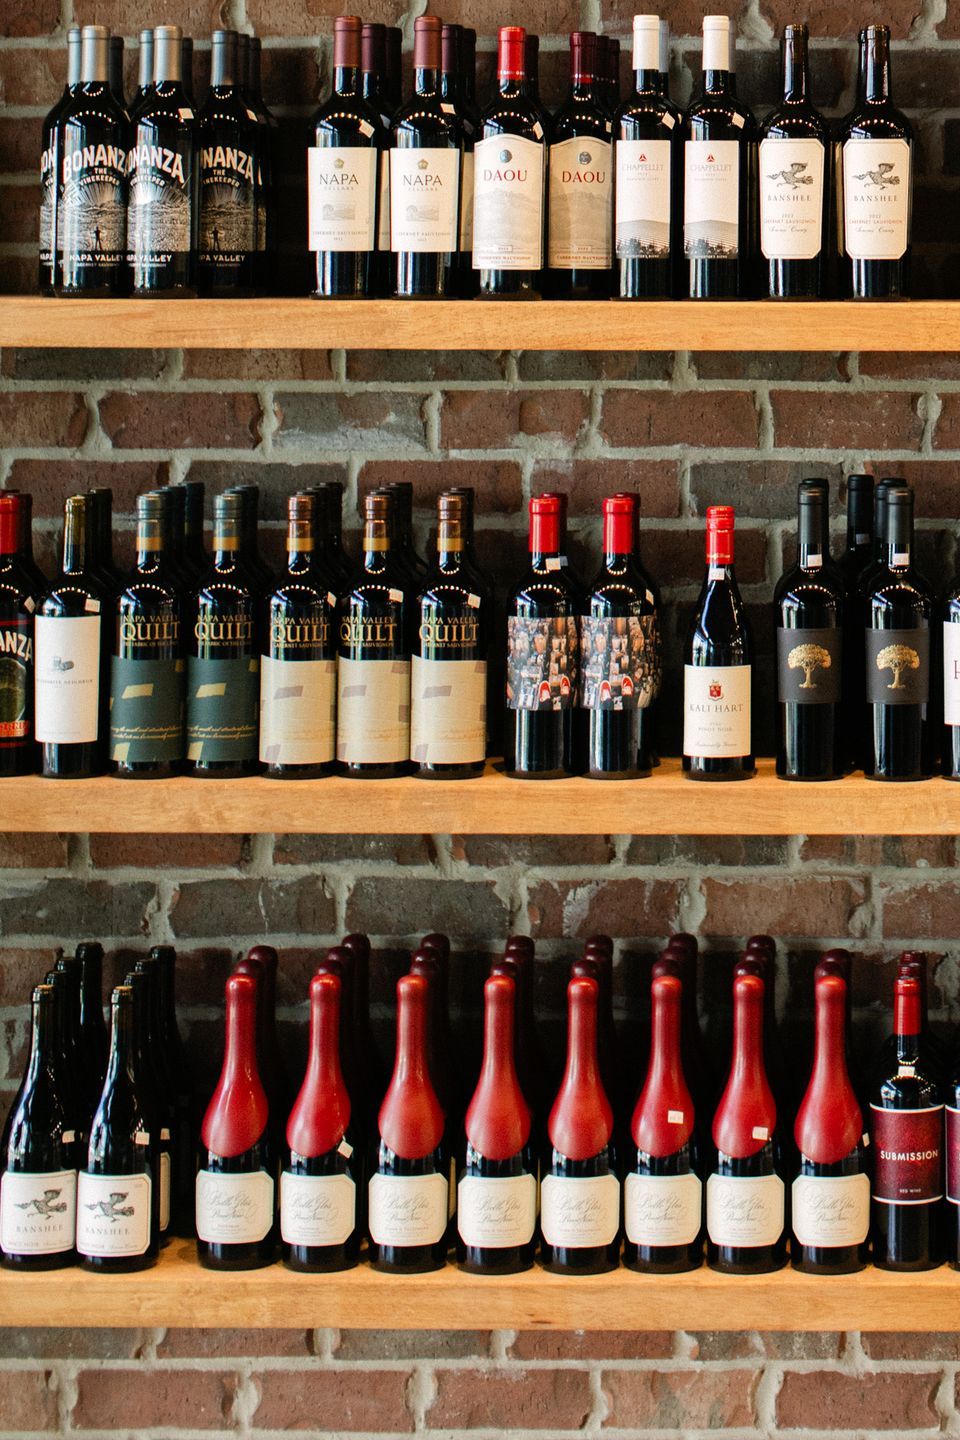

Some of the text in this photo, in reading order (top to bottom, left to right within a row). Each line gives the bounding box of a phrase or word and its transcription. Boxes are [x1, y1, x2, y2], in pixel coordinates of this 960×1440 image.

[319, 174, 359, 185] NAPA
[402, 175, 443, 186] NAPA
[483, 169, 528, 182] DAOU
[562, 170, 606, 183] DAOU
[767, 194, 812, 202] BANSHEE
[853, 194, 898, 202] BANSHEE
[120, 621, 181, 641] QUILT
[194, 621, 254, 641] QUILT
[270, 623, 330, 644] QUILT
[340, 623, 397, 642] QUILT
[418, 623, 479, 642] QUILT
[689, 703, 744, 713] KALI HART
[880, 1149, 939, 1162] SUBMISSION
[16, 1224, 64, 1233] BANSHEE
[85, 1227, 131, 1236] BANSHEE
